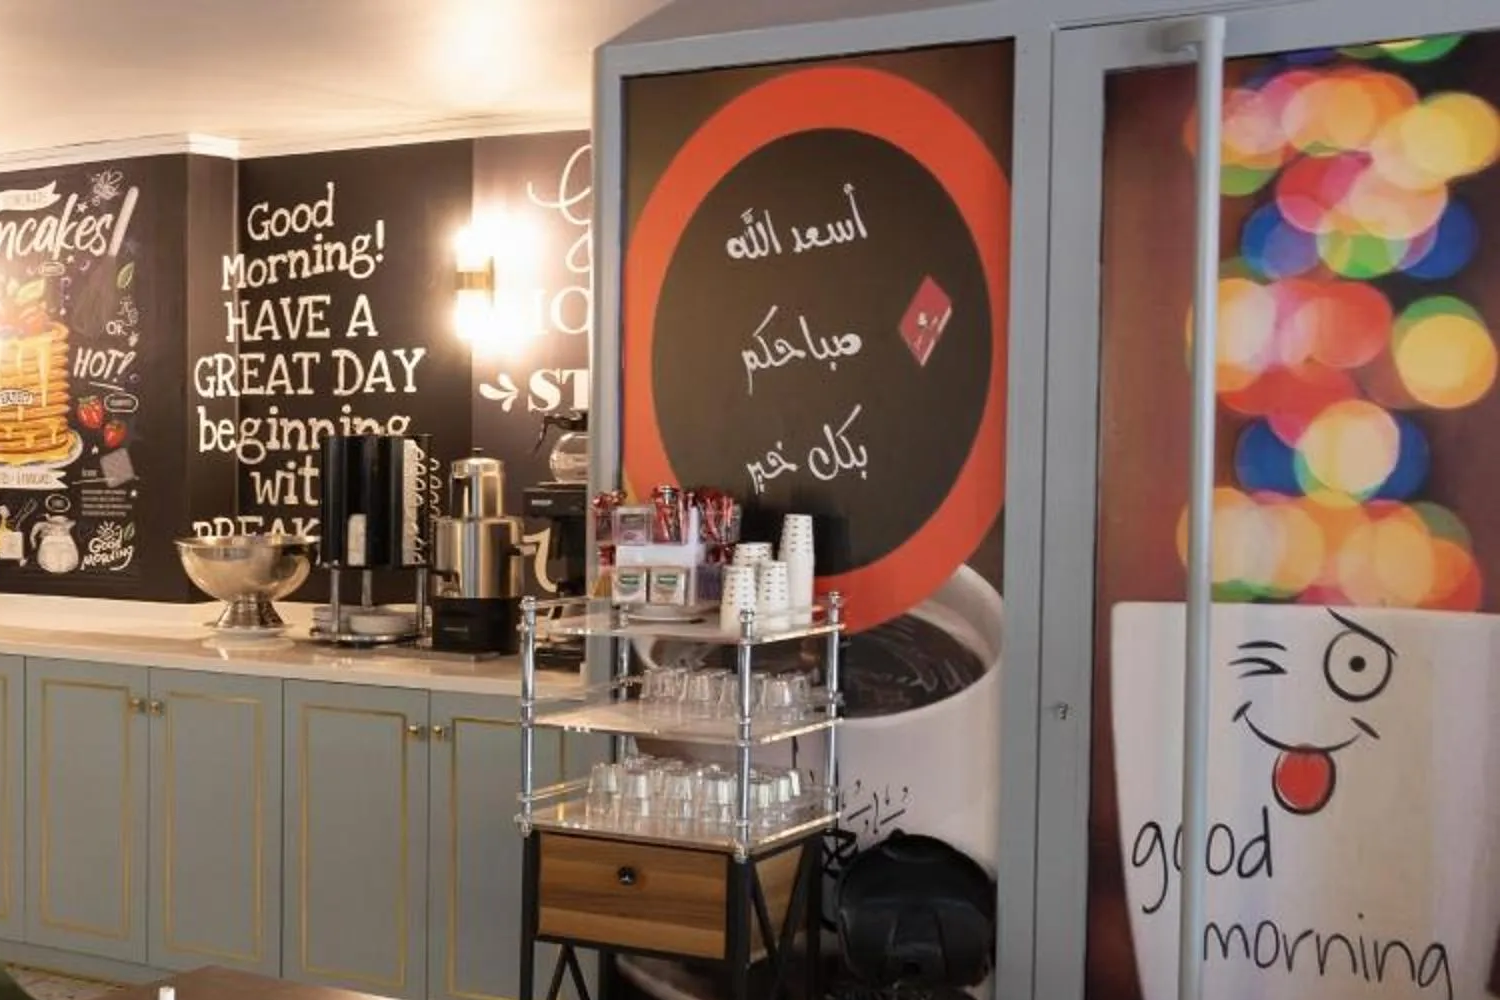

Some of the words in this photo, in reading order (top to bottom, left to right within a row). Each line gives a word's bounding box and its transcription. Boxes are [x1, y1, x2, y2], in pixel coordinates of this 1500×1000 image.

[247, 182, 336, 241] Good
[221, 220, 385, 290] Morning!
[224, 294, 331, 342] HAVE
[346, 294, 379, 338] A
[194, 352, 321, 399] GREAT
[332, 347, 427, 396] DAY
[741, 305, 864, 396] صباحكم
[747, 440, 798, 495] خير
[809, 404, 869, 480] بكل
